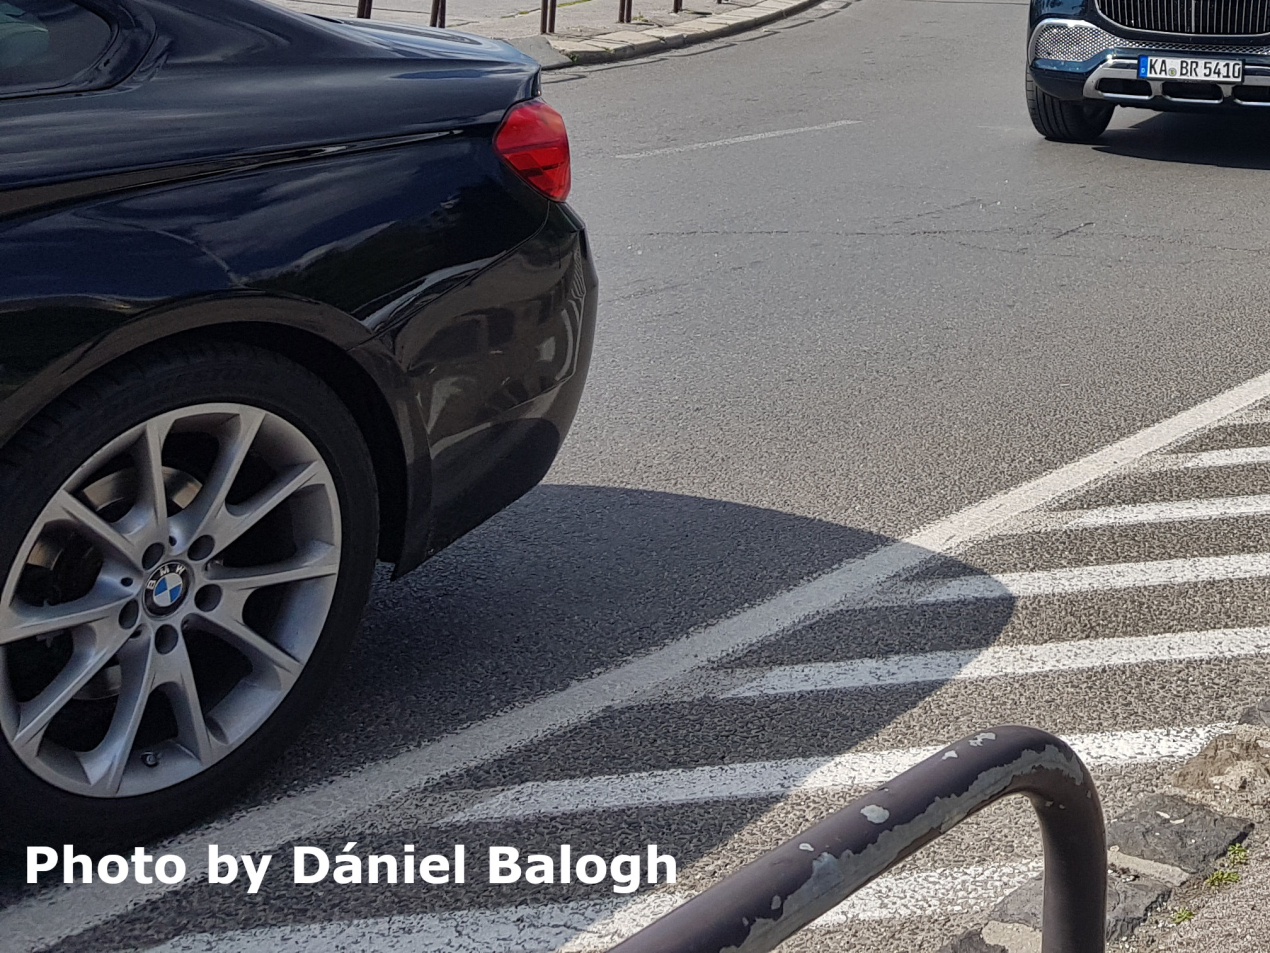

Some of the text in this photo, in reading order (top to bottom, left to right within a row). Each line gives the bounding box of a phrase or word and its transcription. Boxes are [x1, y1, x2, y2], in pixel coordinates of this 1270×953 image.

[1149, 58, 1242, 79] KA BR 5410
[146, 564, 187, 590] BMW
